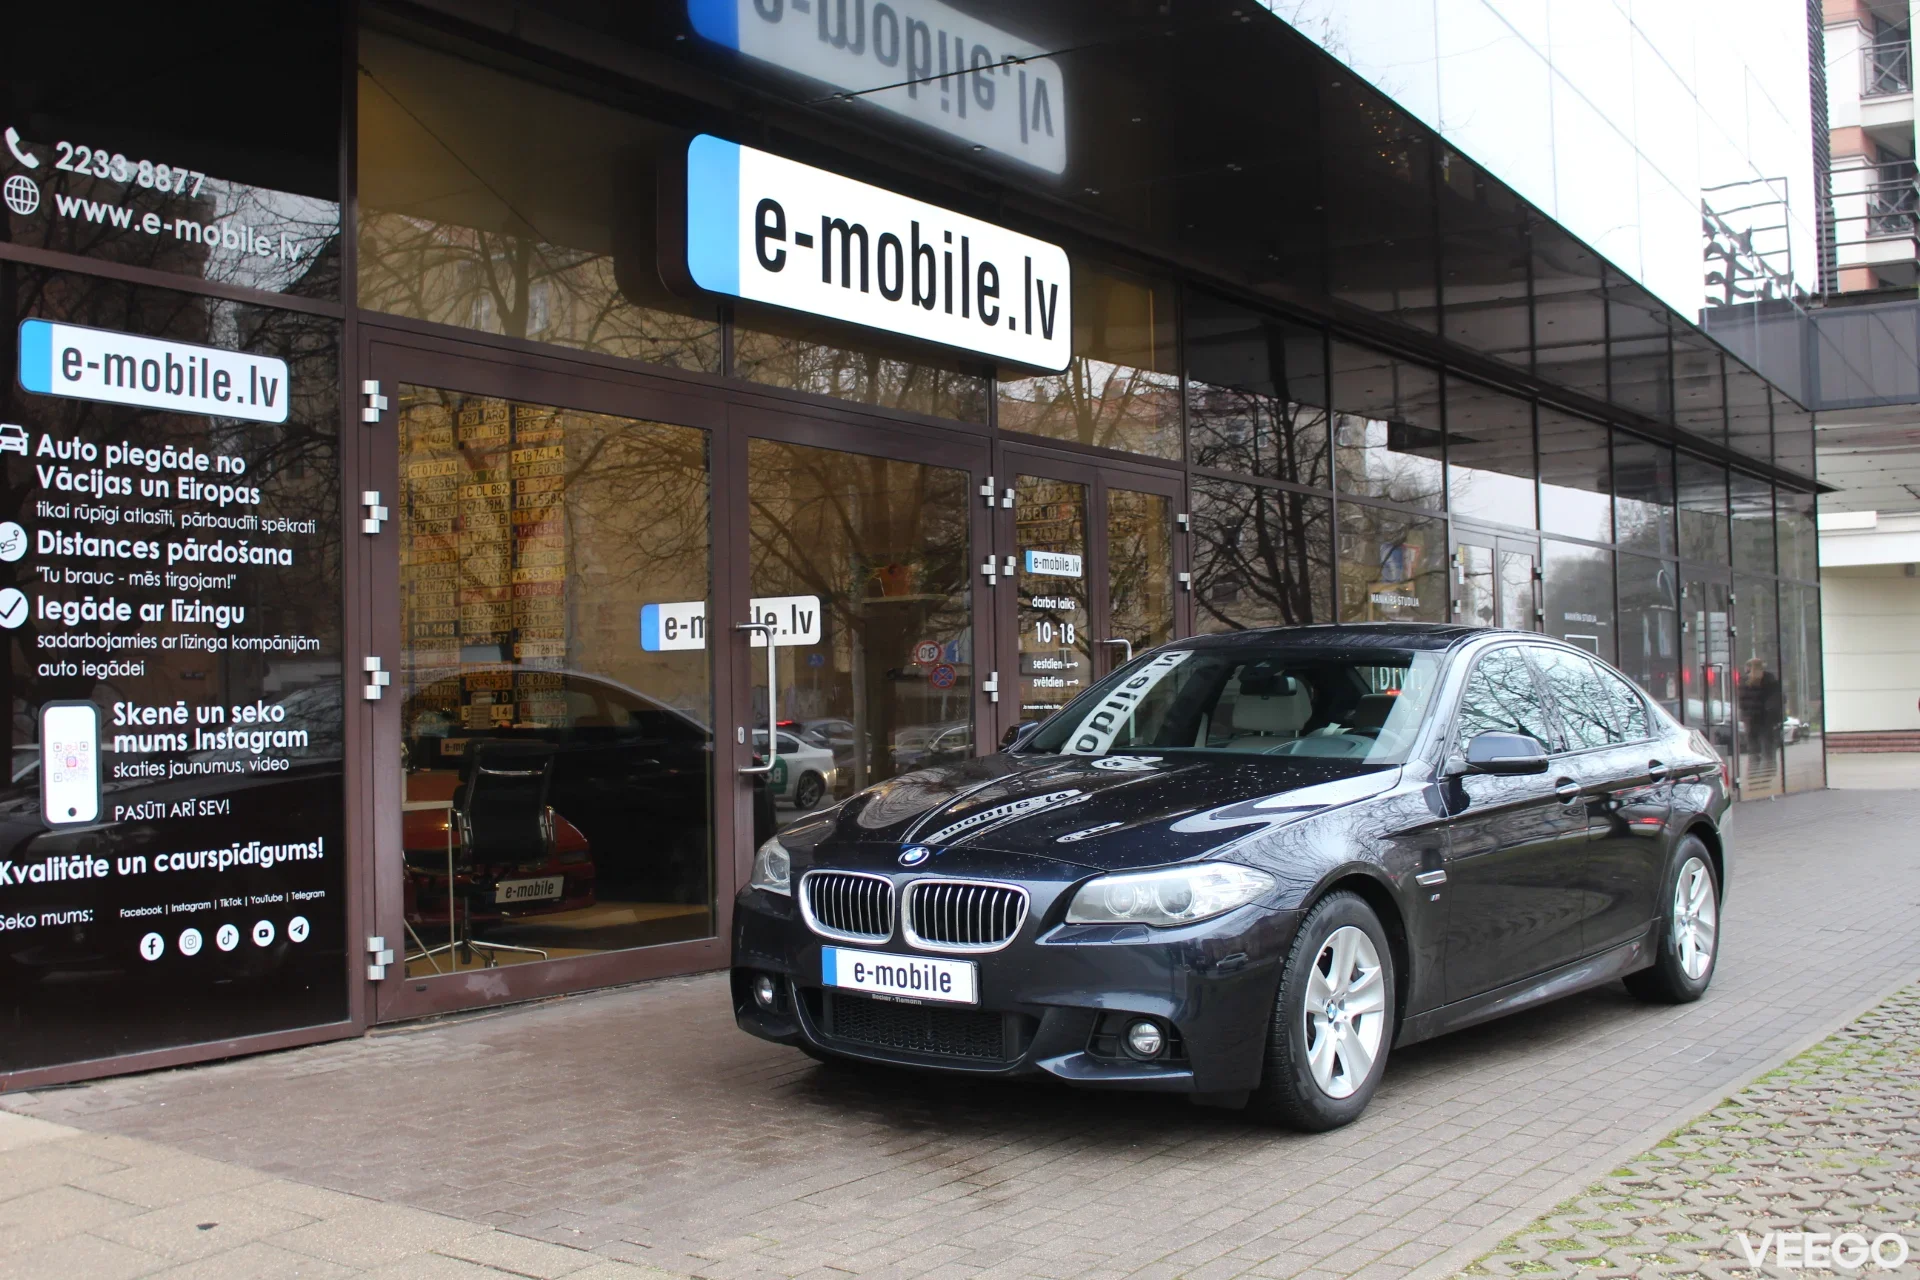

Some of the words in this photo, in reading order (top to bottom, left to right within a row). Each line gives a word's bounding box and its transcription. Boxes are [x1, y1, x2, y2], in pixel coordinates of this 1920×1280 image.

[54, 140, 129, 184] 2233
[136, 158, 207, 200] 8877
[54, 193, 304, 263] www.e-mobile.lv
[754, 197, 1059, 341] e-mobile.lv
[61, 345, 280, 409] e-mobile.lv
[36, 433, 98, 462] Auto
[105, 440, 210, 473] piegāde
[217, 455, 246, 475] no
[36, 464, 133, 499] Vācijas
[140, 478, 170, 498] un
[177, 476, 261, 508] Eiropas
[36, 500, 70, 519] tikai
[74, 503, 119, 525] rūpīgi
[123, 507, 175, 528] atlasīti,
[181, 511, 258, 530] pārbaudīti
[261, 517, 316, 535] spēkrati
[37, 529, 160, 560] Distances
[167, 537, 293, 566] pārdošana
[36, 565, 60, 583] "Tu
[65, 567, 114, 585] brauc
[129, 570, 161, 587] mēs
[1033, 556, 1080, 573] e-mobile.lv
[37, 595, 132, 627] Iegāde
[139, 603, 165, 622] ar
[171, 598, 245, 629] līzingu
[1032, 595, 1056, 609] darba
[1057, 596, 1076, 610] laiks
[37, 631, 158, 652] sadarbojamies
[161, 636, 178, 649] ar
[180, 633, 228, 653] līzinga
[231, 634, 320, 654] kompānijām
[37, 660, 78, 677] auto
[82, 659, 145, 680] iegādei
[1033, 657, 1063, 670] sestdien
[1033, 676, 1064, 688] svētdien
[112, 700, 189, 727] Skenē
[196, 705, 225, 724] un
[231, 699, 286, 724] seko
[113, 731, 189, 754] mums
[195, 726, 308, 755] Instagram
[113, 760, 166, 778] skaties
[168, 759, 245, 779] jaunumus,
[248, 756, 290, 772] video
[115, 800, 166, 822] PASŪTI
[170, 798, 197, 818] ARĪ
[198, 798, 230, 816] SEV!
[0, 854, 110, 886] Kvalitāte
[117, 855, 147, 876] un
[154, 836, 324, 872] caurspīdīgums!
[505, 880, 554, 899] e-mobile
[120, 905, 163, 918] Facebook
[171, 901, 212, 913] Instagram
[219, 897, 242, 907] TikTok
[250, 893, 283, 904] YouTube
[291, 890, 325, 901] Telegram
[0, 912, 37, 931] Seko
[41, 909, 93, 926] mums:
[854, 961, 952, 993] e-mobile
